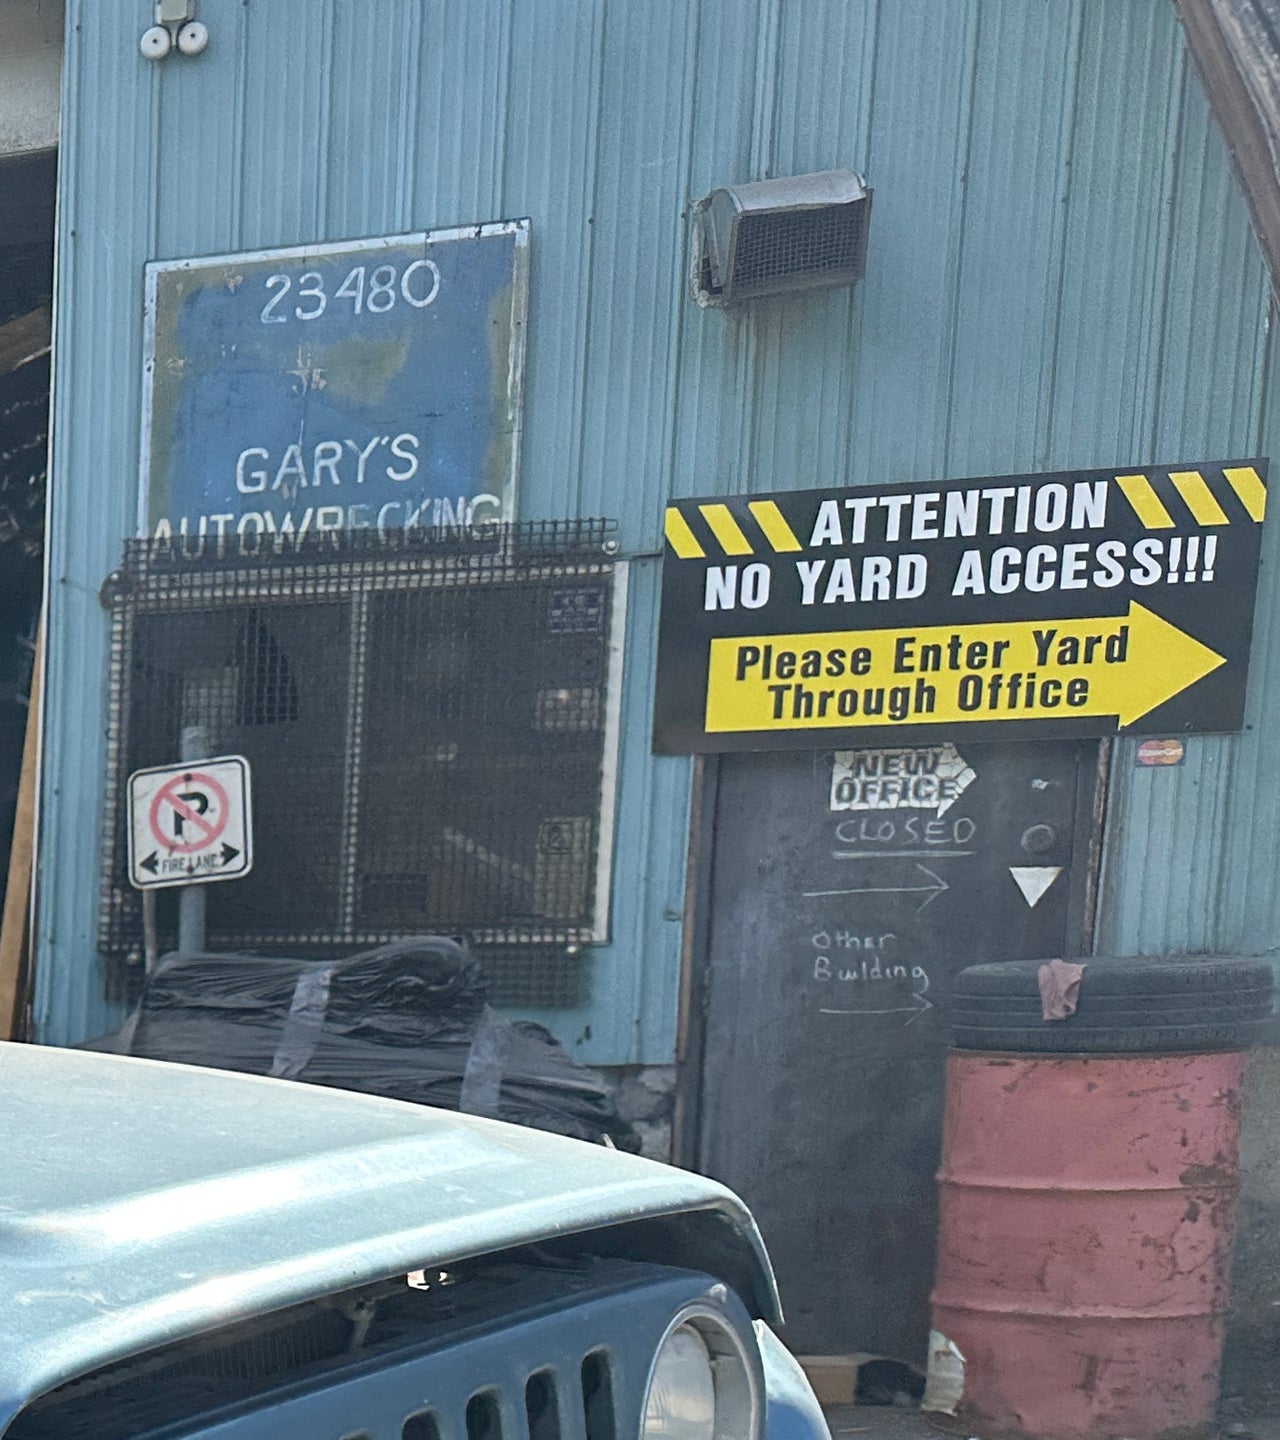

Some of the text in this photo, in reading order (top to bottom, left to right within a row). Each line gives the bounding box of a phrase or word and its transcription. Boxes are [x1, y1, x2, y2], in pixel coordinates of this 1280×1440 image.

[260, 260, 441, 323] 23480
[235, 433, 421, 494] GARY'S
[810, 480, 1109, 547] ATTENTION
[704, 535, 1219, 611] NO YARD ACCESS!!!
[736, 625, 1130, 682] Please Enter Yard
[768, 672, 1090, 721] Through Office
[854, 752, 940, 776] NEW
[835, 777, 958, 802] OFFICE
[836, 816, 976, 845] CLOSED
[812, 930, 896, 949] Other
[814, 955, 929, 994] Building
